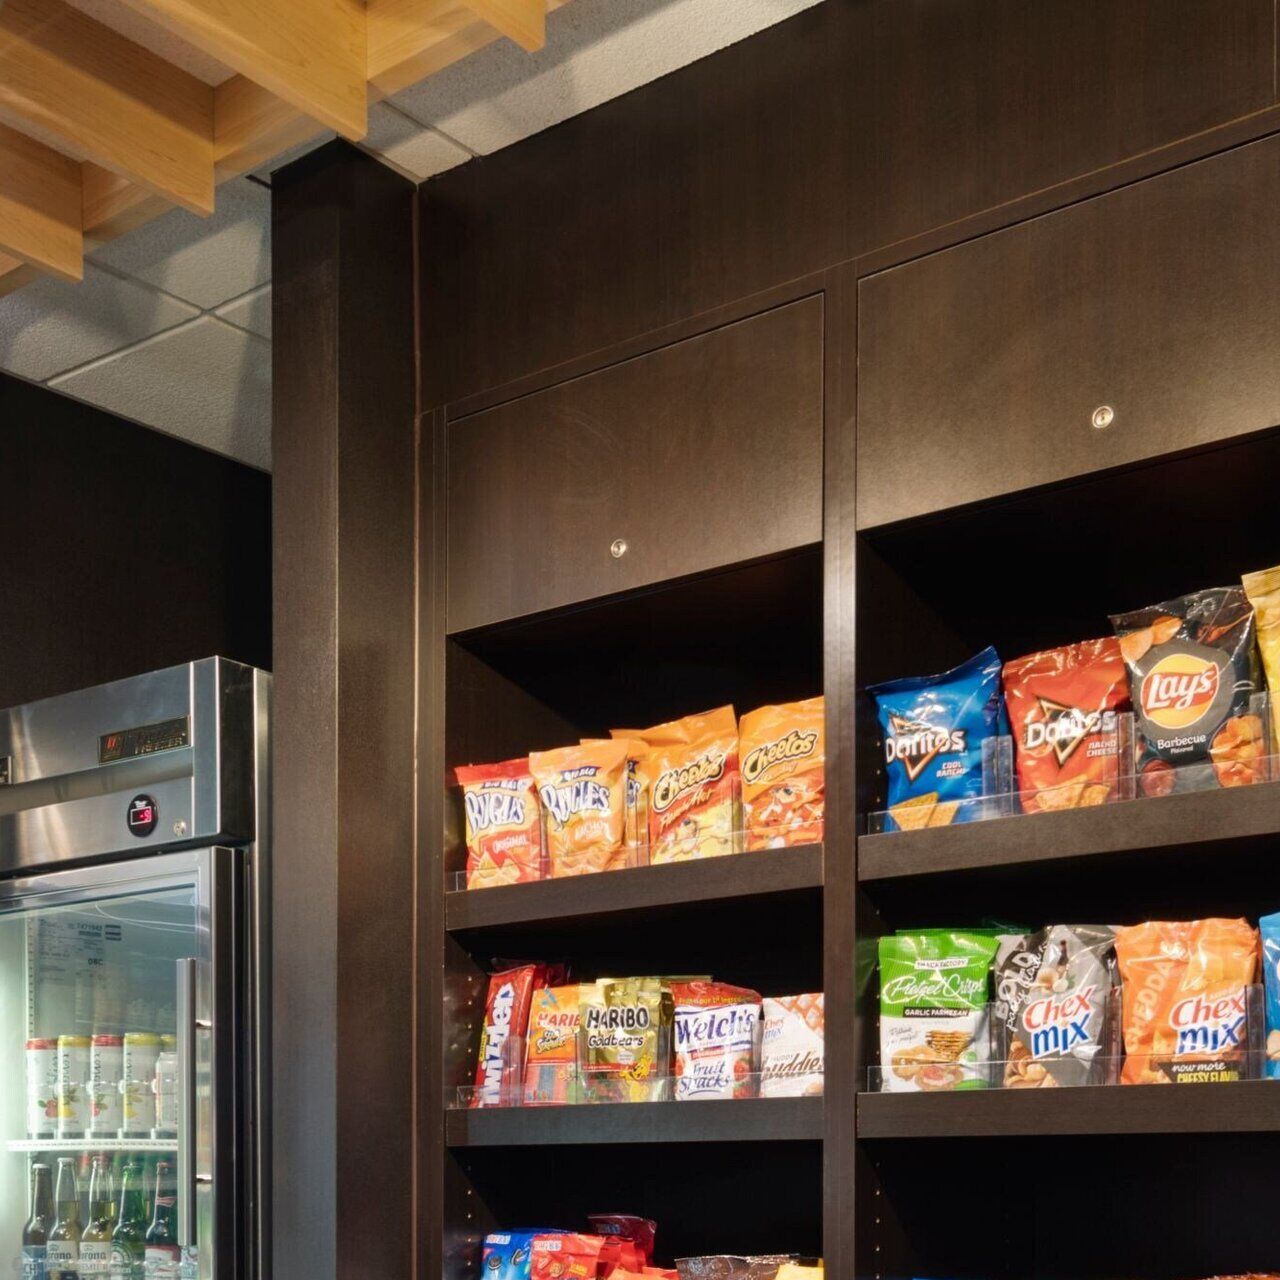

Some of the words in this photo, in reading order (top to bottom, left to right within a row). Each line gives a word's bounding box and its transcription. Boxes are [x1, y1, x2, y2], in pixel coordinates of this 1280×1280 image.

[886, 728, 966, 763] Doritos
[1027, 711, 1117, 747] Doritos
[1157, 734, 1206, 750] Barbecue
[743, 731, 818, 782] Cheetos
[654, 755, 724, 811] Cheetos
[892, 977, 946, 1000] Pretzel
[944, 974, 986, 1000] Crisps
[586, 1006, 649, 1029] HARIBO
[904, 1009, 931, 1018] GARLIC
[931, 1008, 970, 1018] PARMESAN
[1023, 987, 1096, 1031] Chex
[1171, 992, 1245, 1030] Chex
[588, 1034, 645, 1048] Goldbears
[675, 1009, 756, 1045] Welch's
[1032, 1014, 1091, 1058] mix
[1177, 1016, 1245, 1055] mix
[693, 1060, 725, 1075] Fruit
[1172, 1063, 1193, 1072] now
[1193, 1061, 1225, 1071] more
